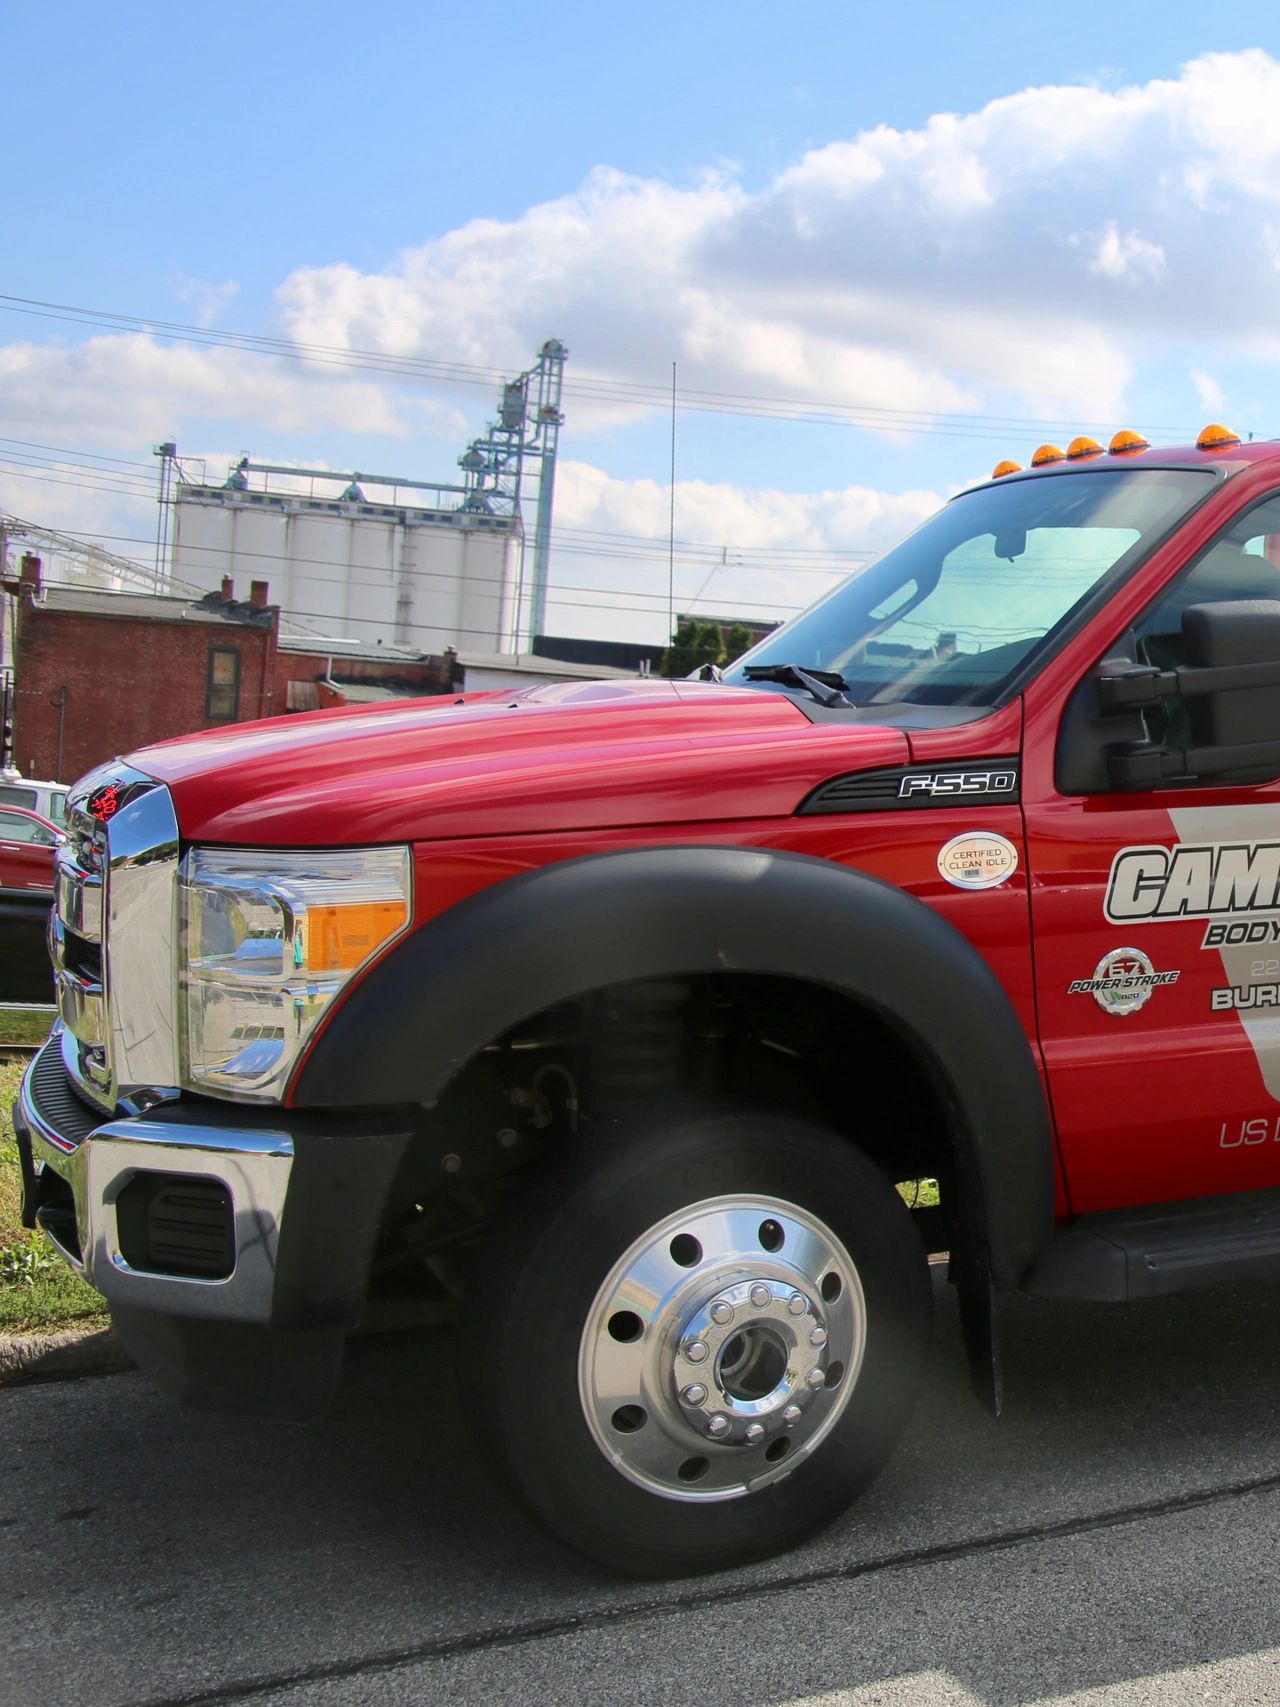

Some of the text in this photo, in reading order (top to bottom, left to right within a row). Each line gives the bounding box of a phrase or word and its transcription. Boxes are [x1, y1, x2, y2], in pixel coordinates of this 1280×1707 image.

[898, 772, 1016, 798] F-550
[949, 857, 1008, 870] CLEAN IDLE
[953, 848, 1002, 860] CERTIFIED
[1068, 971, 1180, 994] POWER STROKE
[1219, 1118, 1268, 1148] US
